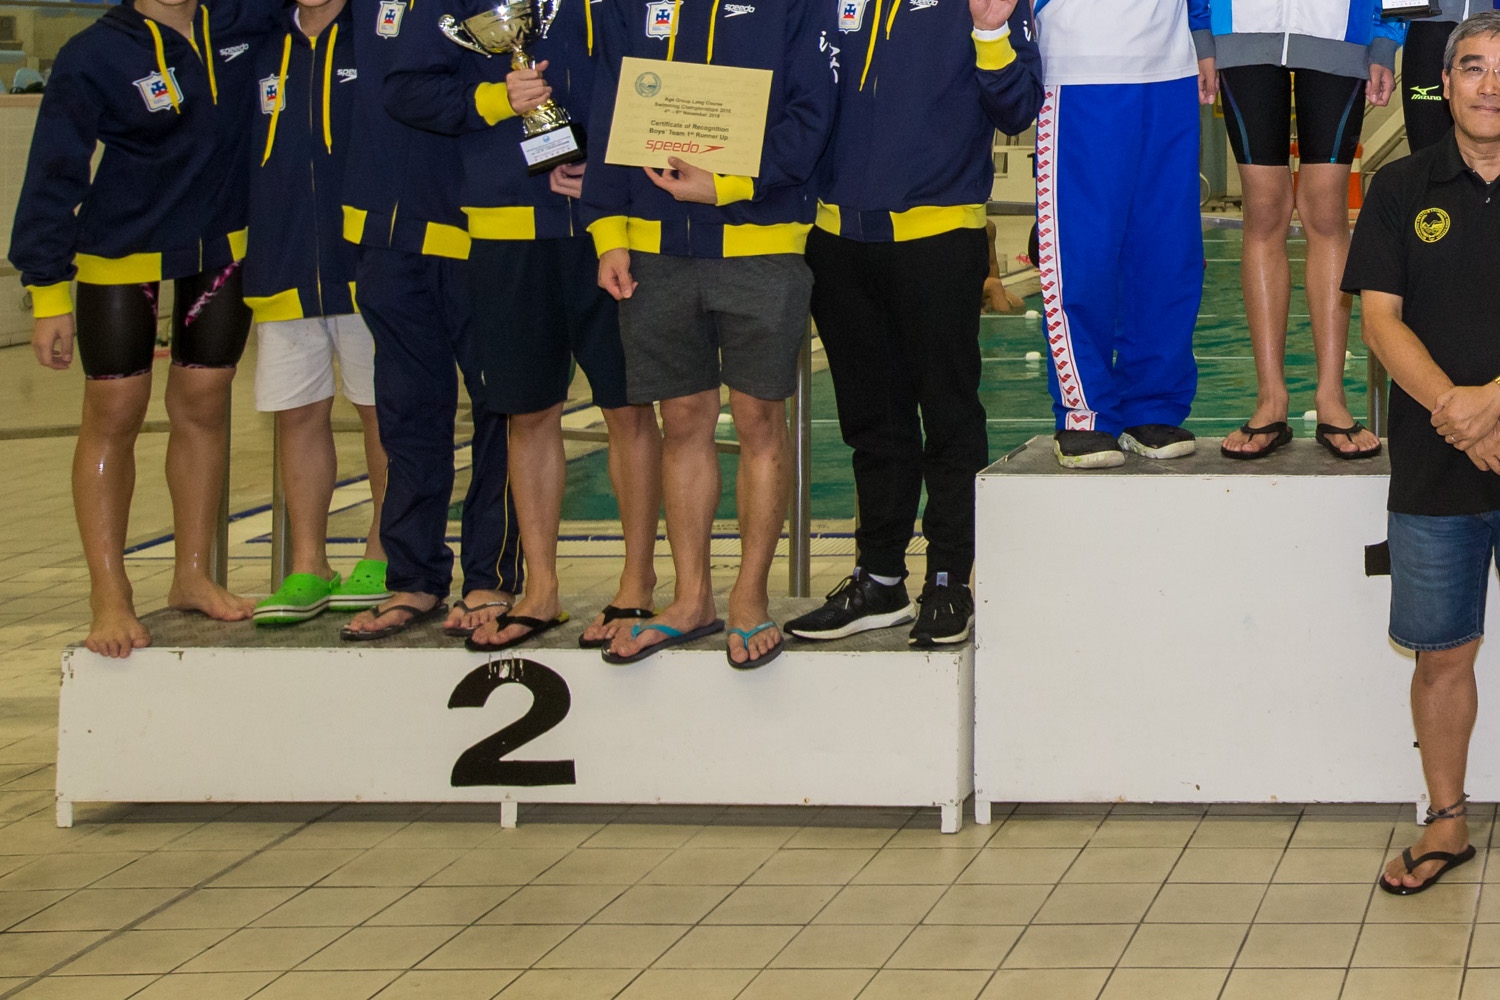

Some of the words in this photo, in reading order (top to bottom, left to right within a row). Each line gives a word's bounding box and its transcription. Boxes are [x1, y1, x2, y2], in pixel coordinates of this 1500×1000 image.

[724, 2, 756, 14] speedo
[219, 43, 250, 57] speedo
[650, 119, 683, 129] Certificate
[692, 123, 730, 133] Recognition
[669, 129, 685, 137] Team
[695, 131, 719, 140] Runner
[644, 139, 701, 155] speedo
[447, 658, 577, 787] 2
